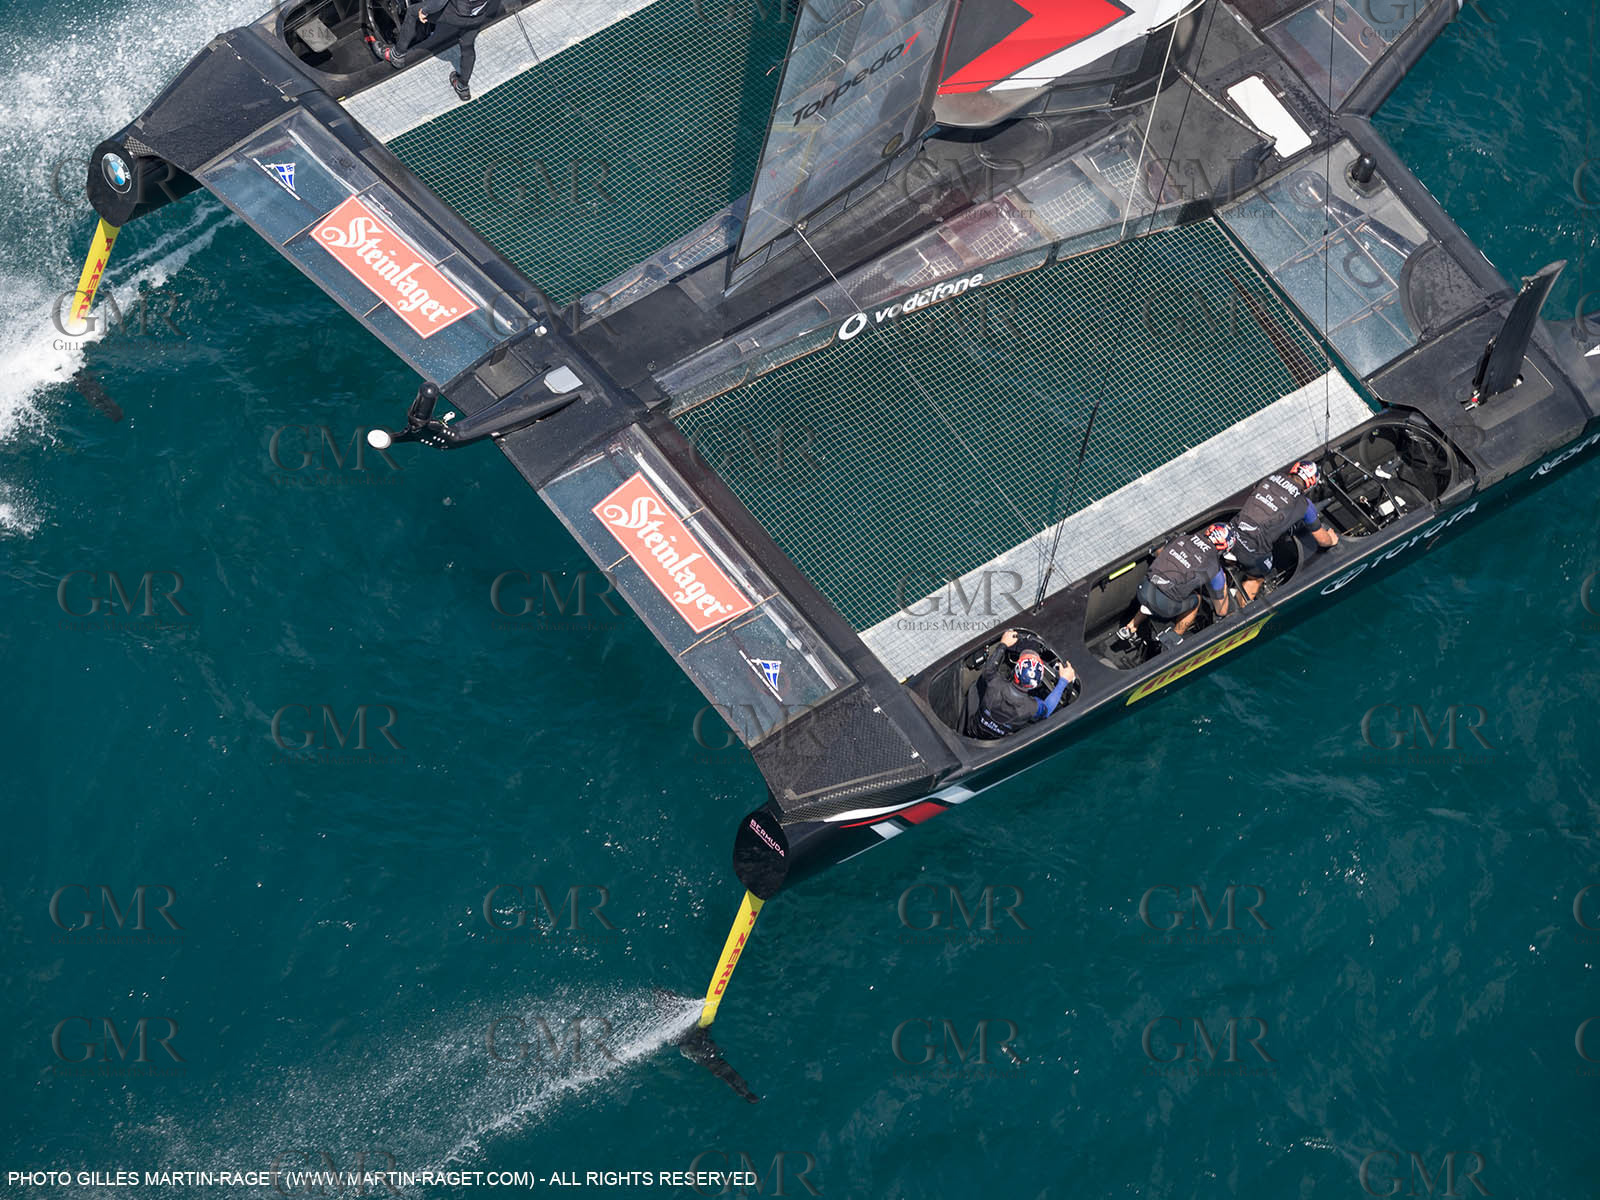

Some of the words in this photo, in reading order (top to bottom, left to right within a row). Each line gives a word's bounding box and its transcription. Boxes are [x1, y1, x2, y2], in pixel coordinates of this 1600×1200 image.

[321, 216, 454, 322] Steinlager
[875, 273, 984, 323] vodafone
[603, 496, 732, 617] Steinlager
[1190, 535, 1211, 553] TUKE
[1371, 502, 1479, 568] TOYOTA
[750, 818, 785, 857] BERMUDA
[714, 931, 748, 996] ZERO
